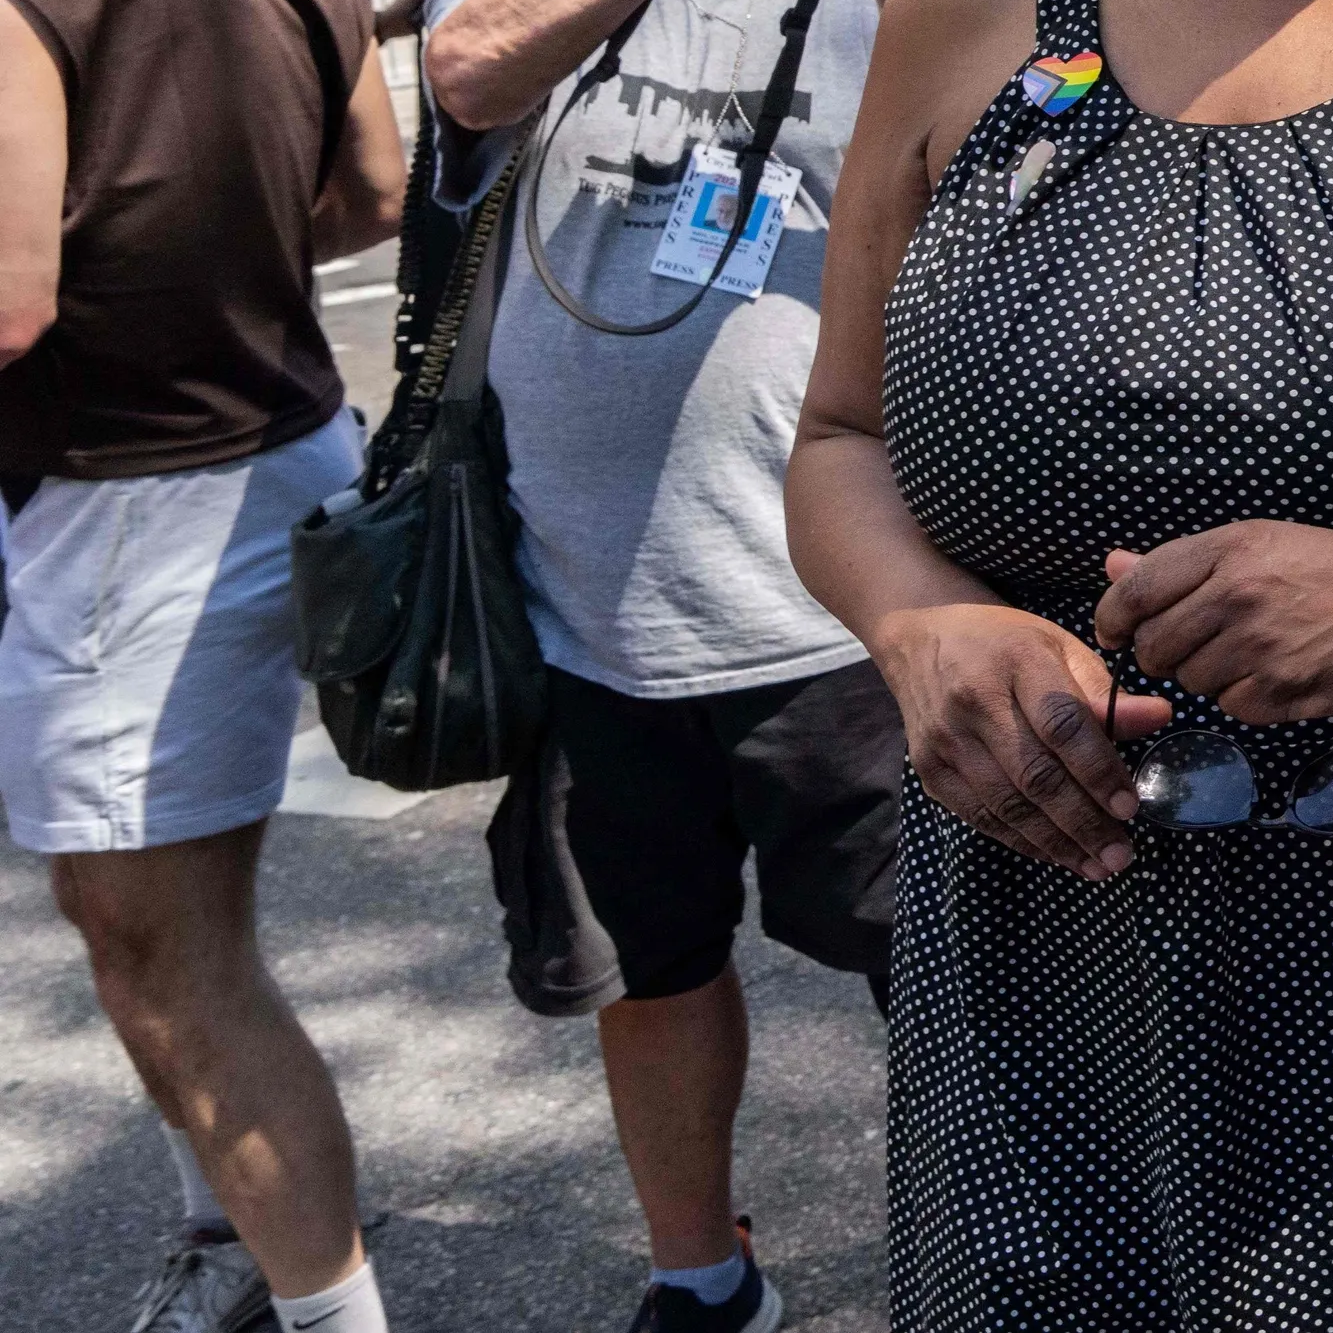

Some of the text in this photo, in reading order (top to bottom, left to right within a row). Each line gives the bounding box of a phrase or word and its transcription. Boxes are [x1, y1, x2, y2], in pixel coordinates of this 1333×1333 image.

[713, 173, 738, 186] 202
[664, 169, 700, 244] PRESS
[756, 192, 790, 267] PRESS
[655, 259, 695, 275] PRESS
[720, 274, 759, 290] PRESS
